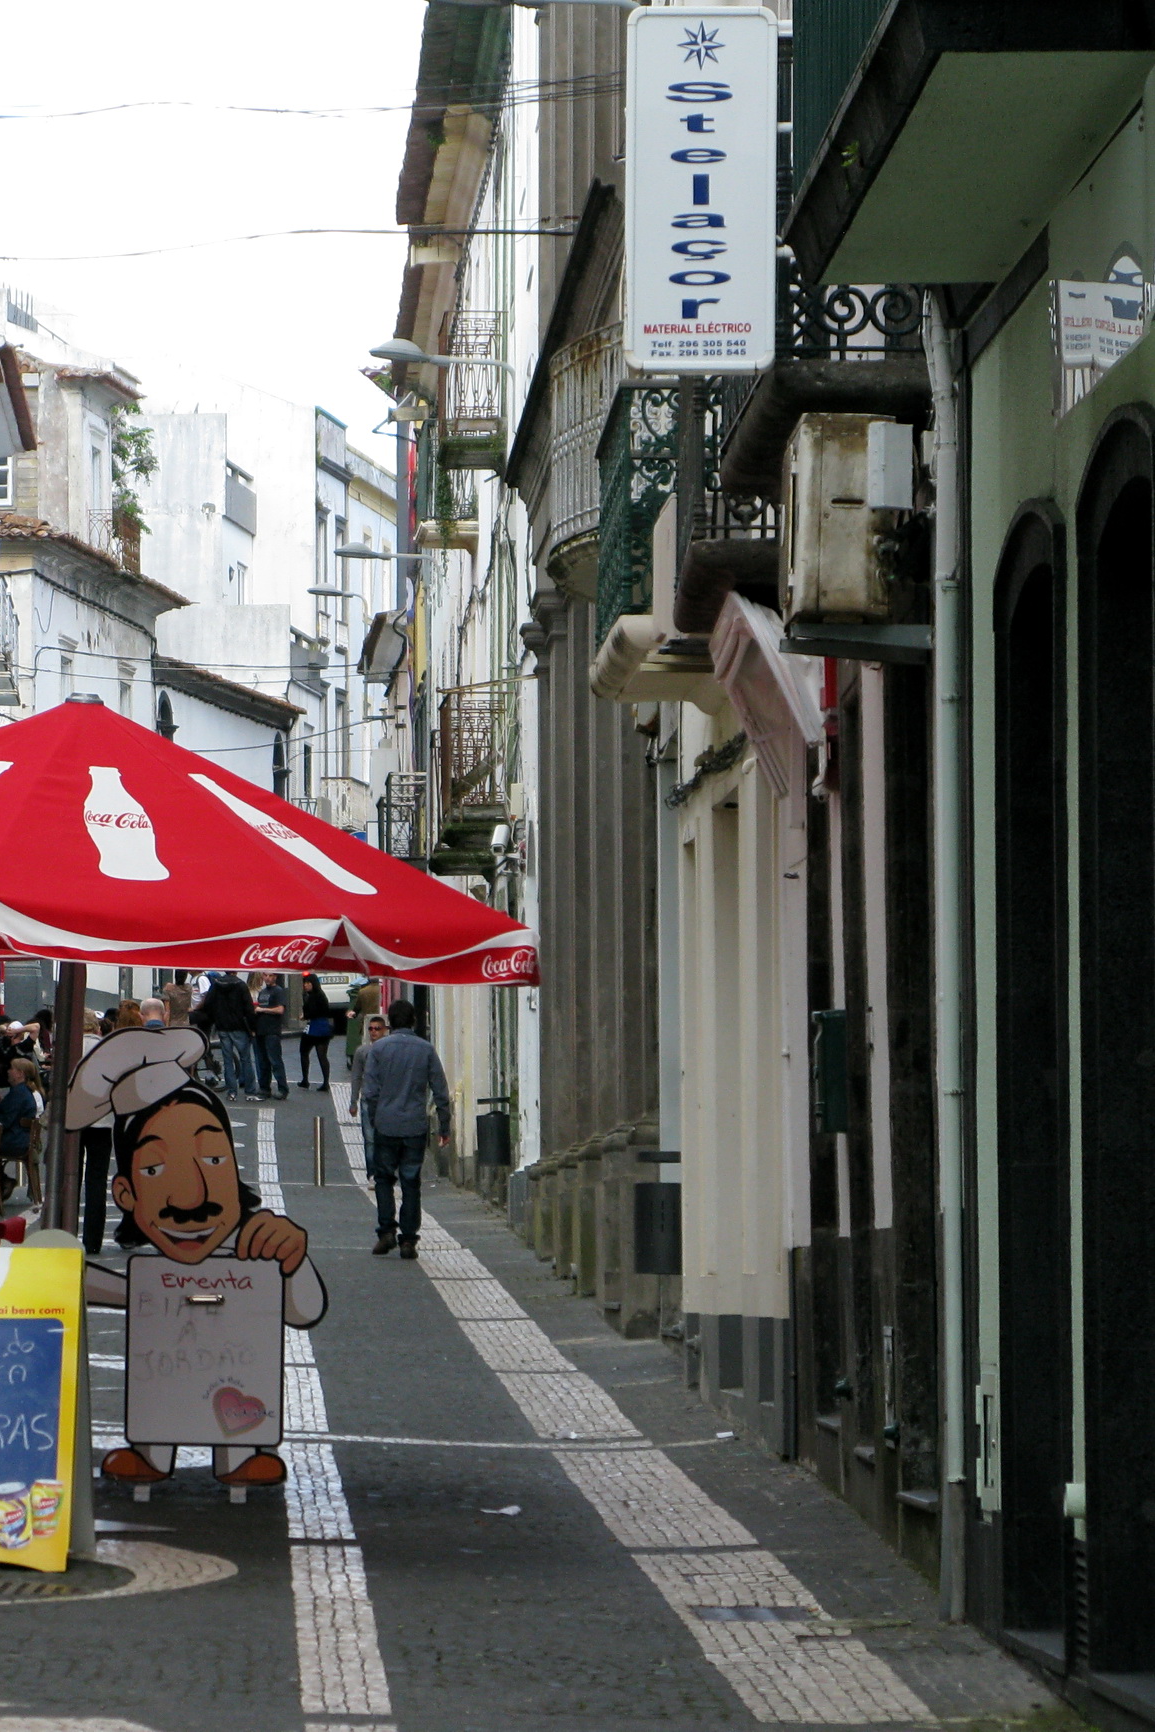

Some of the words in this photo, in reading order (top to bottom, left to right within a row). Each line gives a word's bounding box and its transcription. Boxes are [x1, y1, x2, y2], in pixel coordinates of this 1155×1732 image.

[665, 81, 734, 320] Stelaçor
[643, 323, 693, 335] MATERIAL
[695, 321, 752, 334] ELÉCTRICO
[650, 340, 675, 348] Telf.
[678, 340, 699, 348] 296
[726, 339, 747, 347] 540
[650, 349, 675, 357] Fax.
[678, 349, 699, 357] 296
[726, 348, 747, 356] 545
[85, 810, 151, 830] Coca-Cola
[239, 938, 324, 967] Coca-Cola
[161, 1269, 254, 1290] Ementa
[11, 1305, 36, 1315] bem
[39, 1307, 66, 1316] com:
